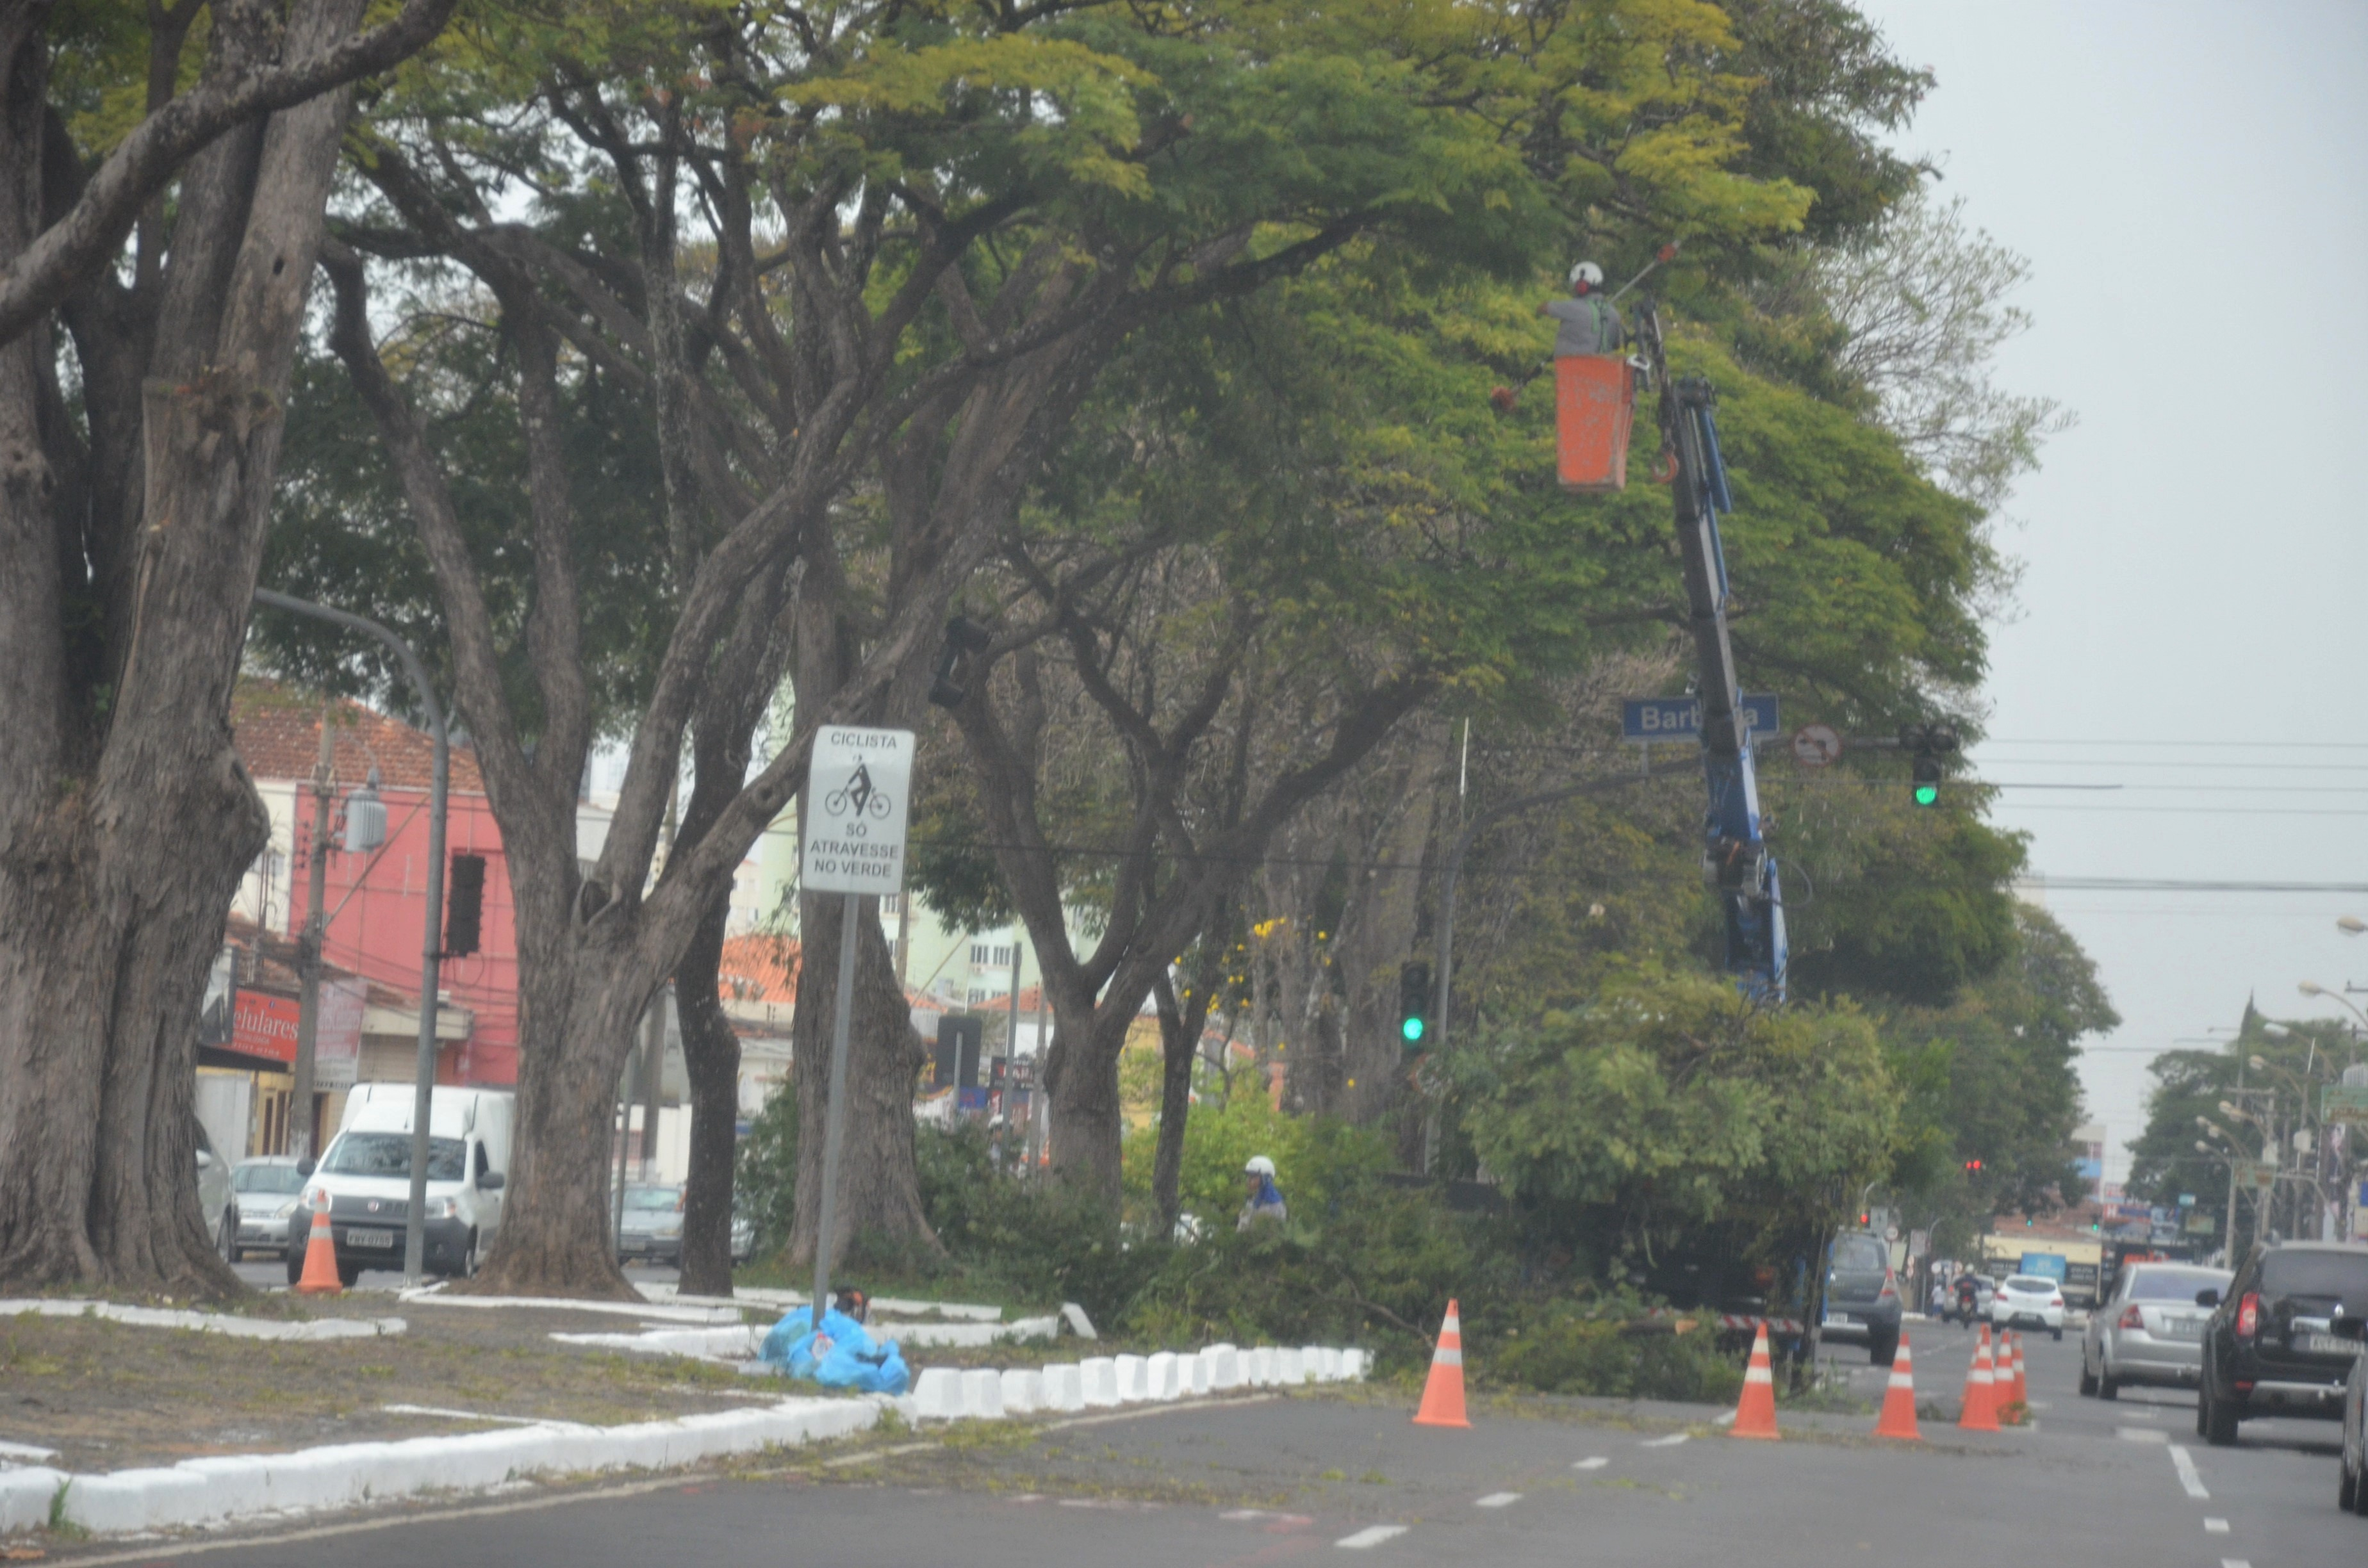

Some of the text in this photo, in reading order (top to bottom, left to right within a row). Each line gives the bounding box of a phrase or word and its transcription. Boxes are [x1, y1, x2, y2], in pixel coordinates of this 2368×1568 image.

[1641, 705, 1758, 730] Barba
[831, 732, 897, 748] CICLISTA
[810, 840, 898, 858] ATRAVESSE
[814, 860, 891, 878] NO VERDE
[233, 1005, 299, 1040] elulares
